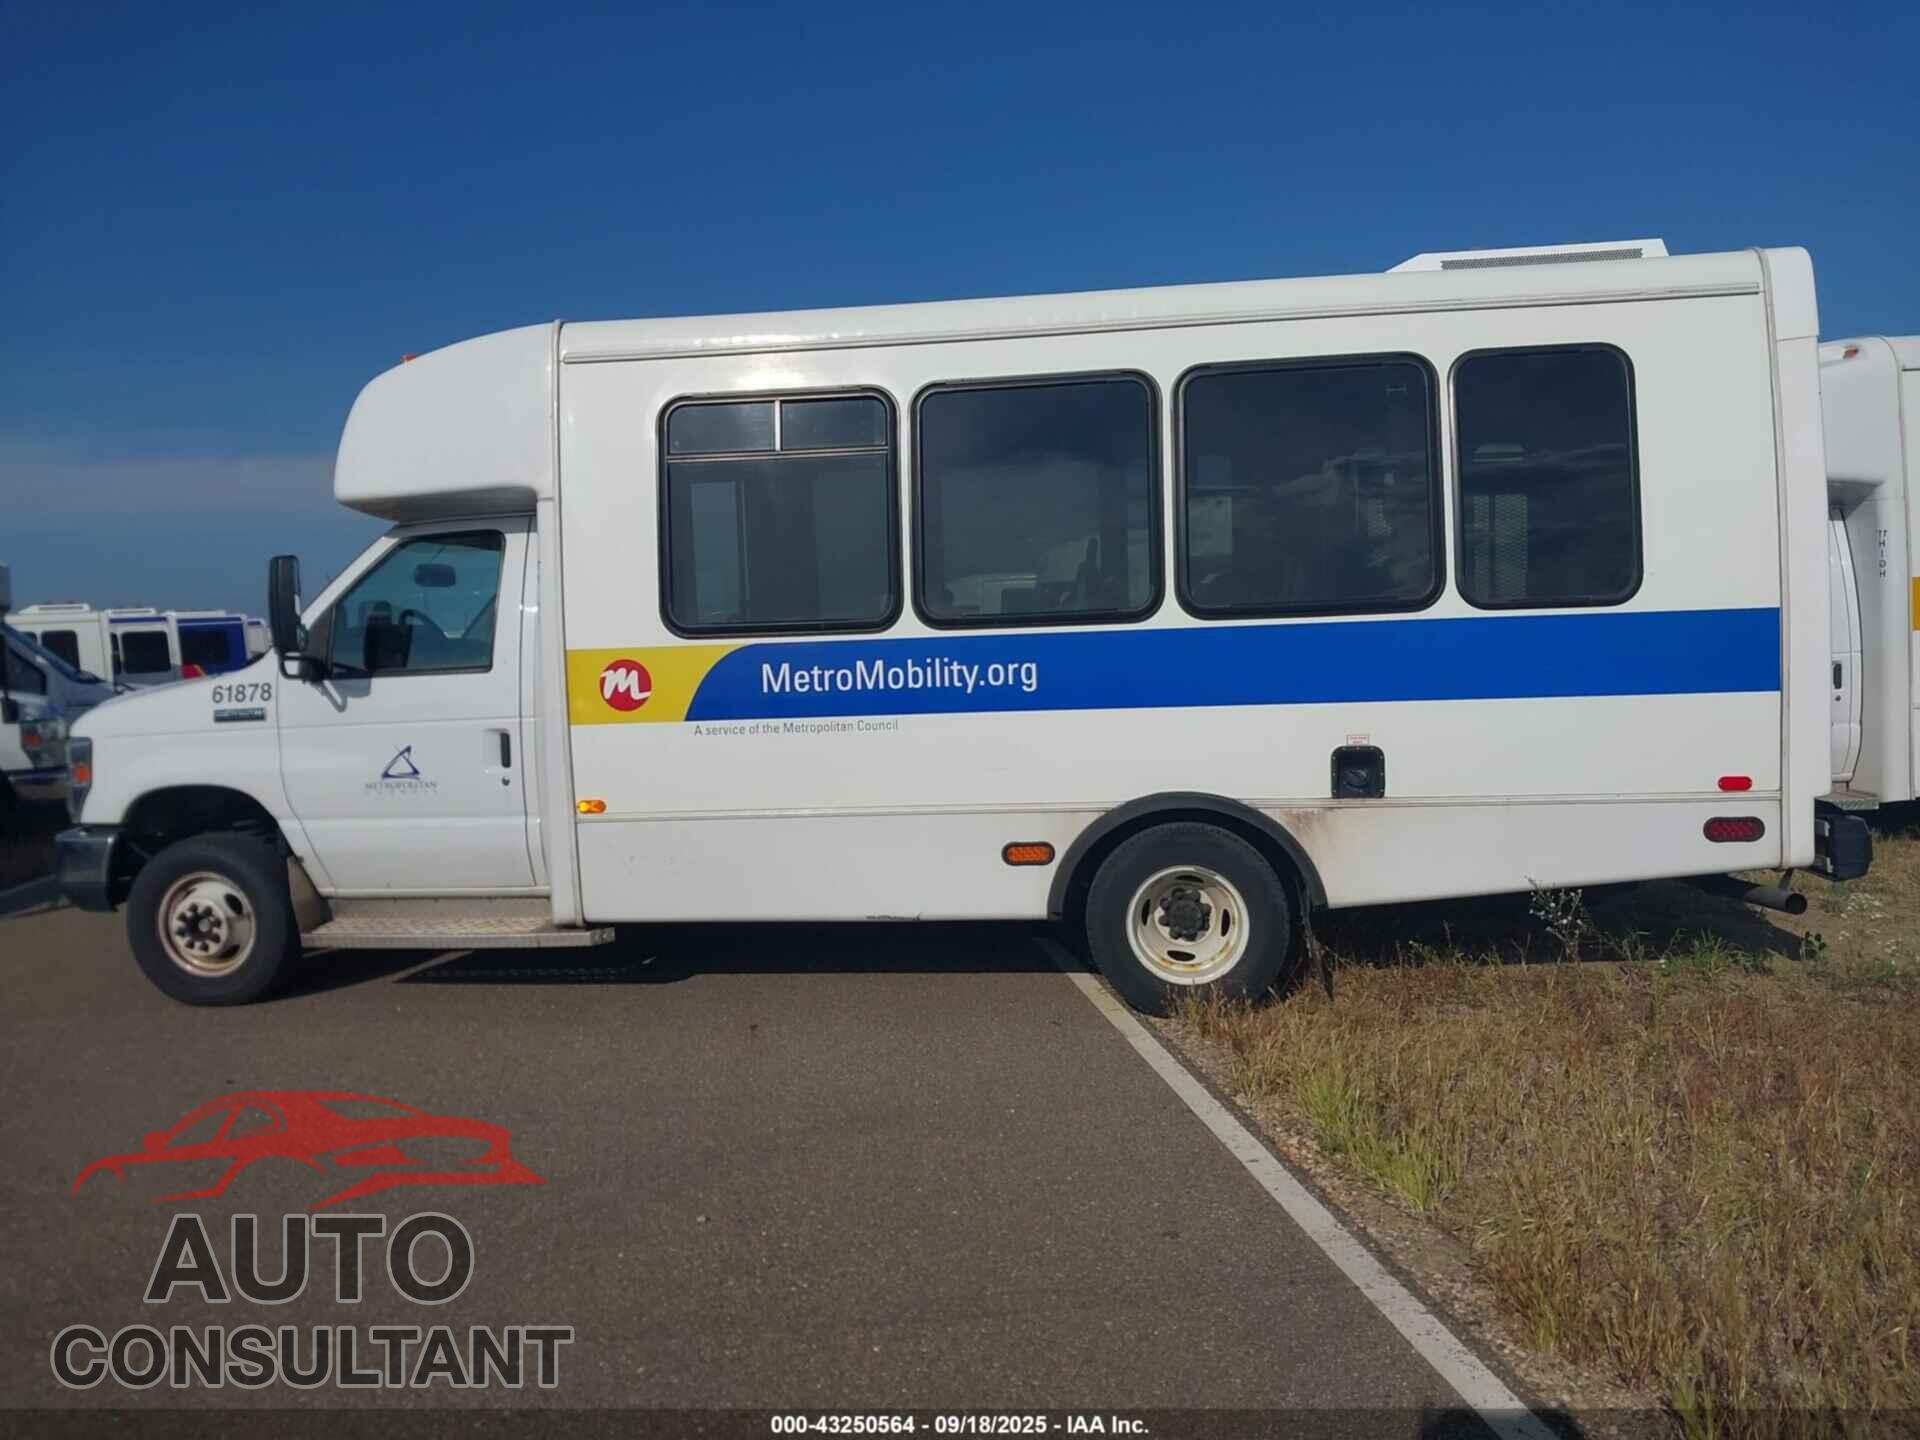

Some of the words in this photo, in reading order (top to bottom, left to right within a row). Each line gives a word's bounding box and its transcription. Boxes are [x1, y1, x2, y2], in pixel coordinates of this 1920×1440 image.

[761, 659, 1037, 694] MetroMobility.org
[212, 682, 272, 704] 61878
[694, 725, 703, 736] A
[705, 724, 745, 736] service
[749, 723, 762, 735] of
[762, 723, 780, 734] the
[783, 721, 853, 735] Metropolitan
[857, 719, 899, 732] Council
